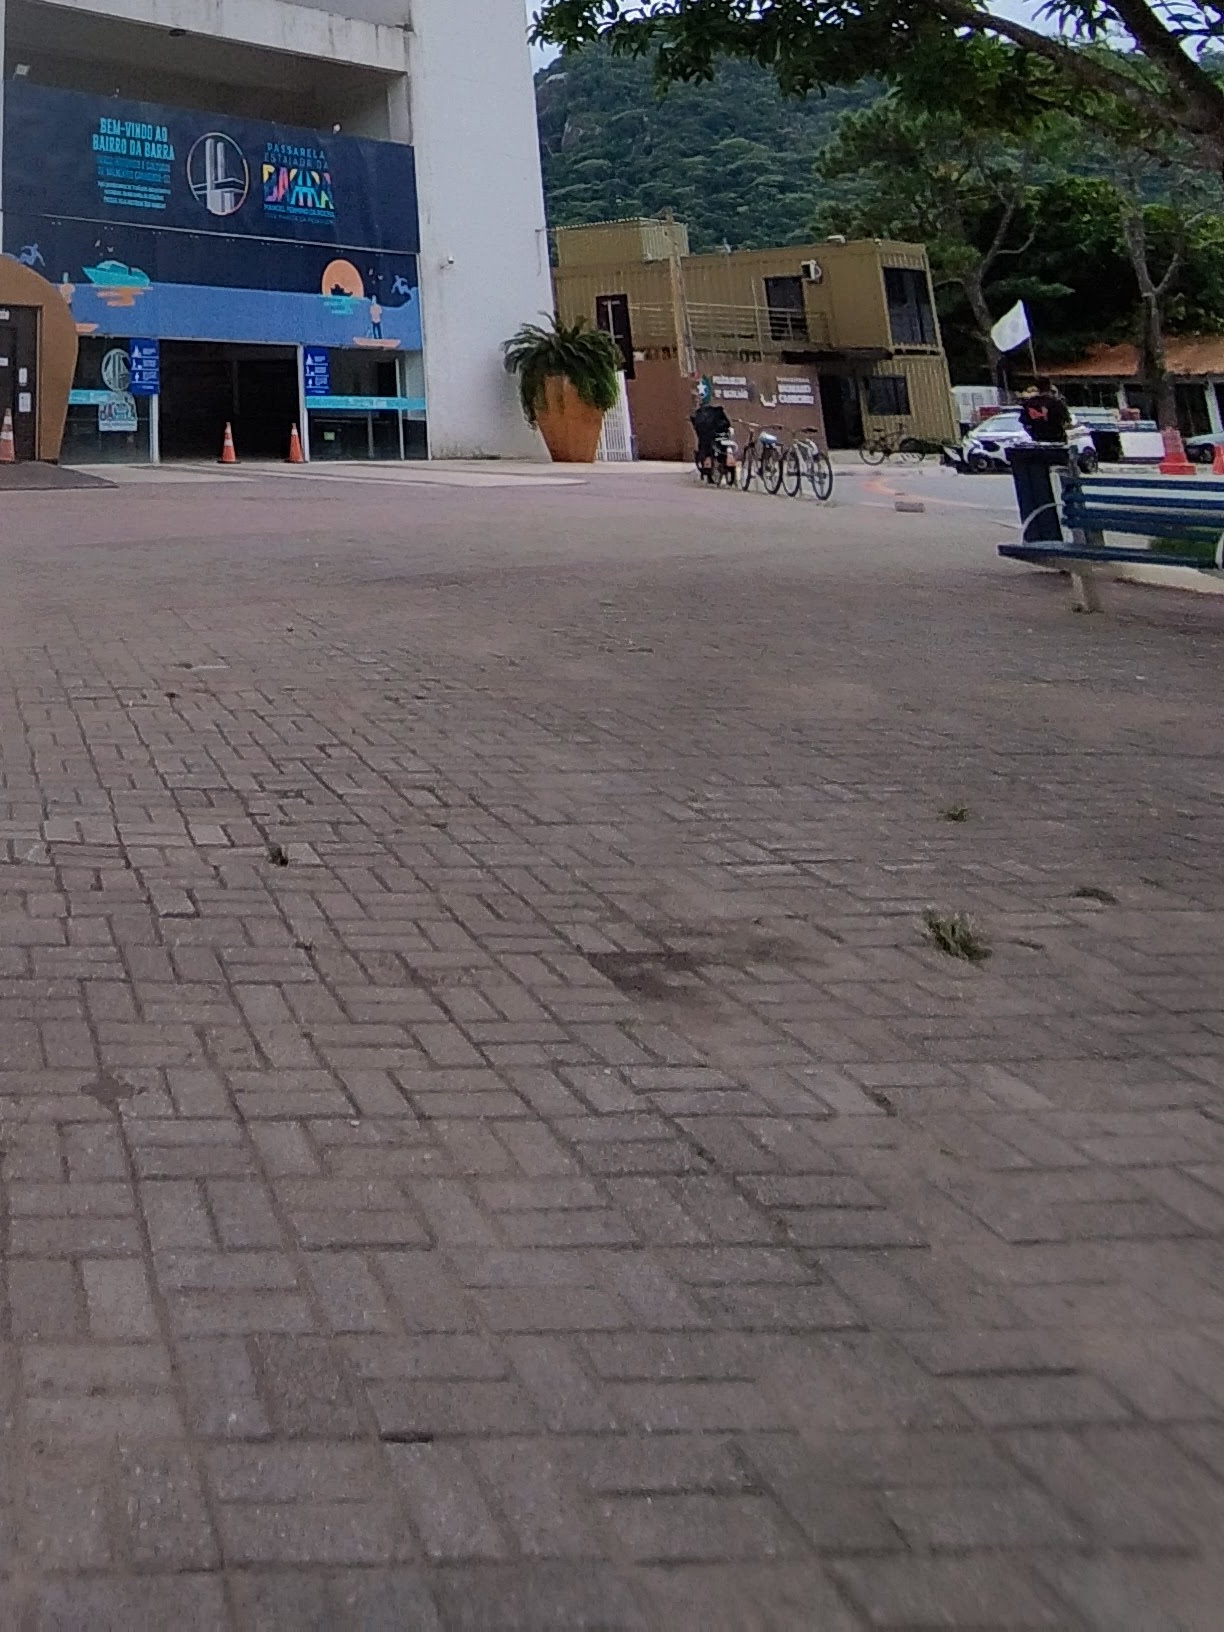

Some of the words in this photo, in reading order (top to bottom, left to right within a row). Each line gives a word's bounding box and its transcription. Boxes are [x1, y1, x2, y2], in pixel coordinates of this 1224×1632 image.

[99, 117, 153, 141] BEM-VINDO
[154, 125, 168, 142] AO
[92, 133, 127, 155] BAIRRO
[129, 139, 143, 157] DA
[144, 141, 175, 161] BARRA
[266, 142, 326, 160] PASSARELA
[316, 159, 329, 170] DA
